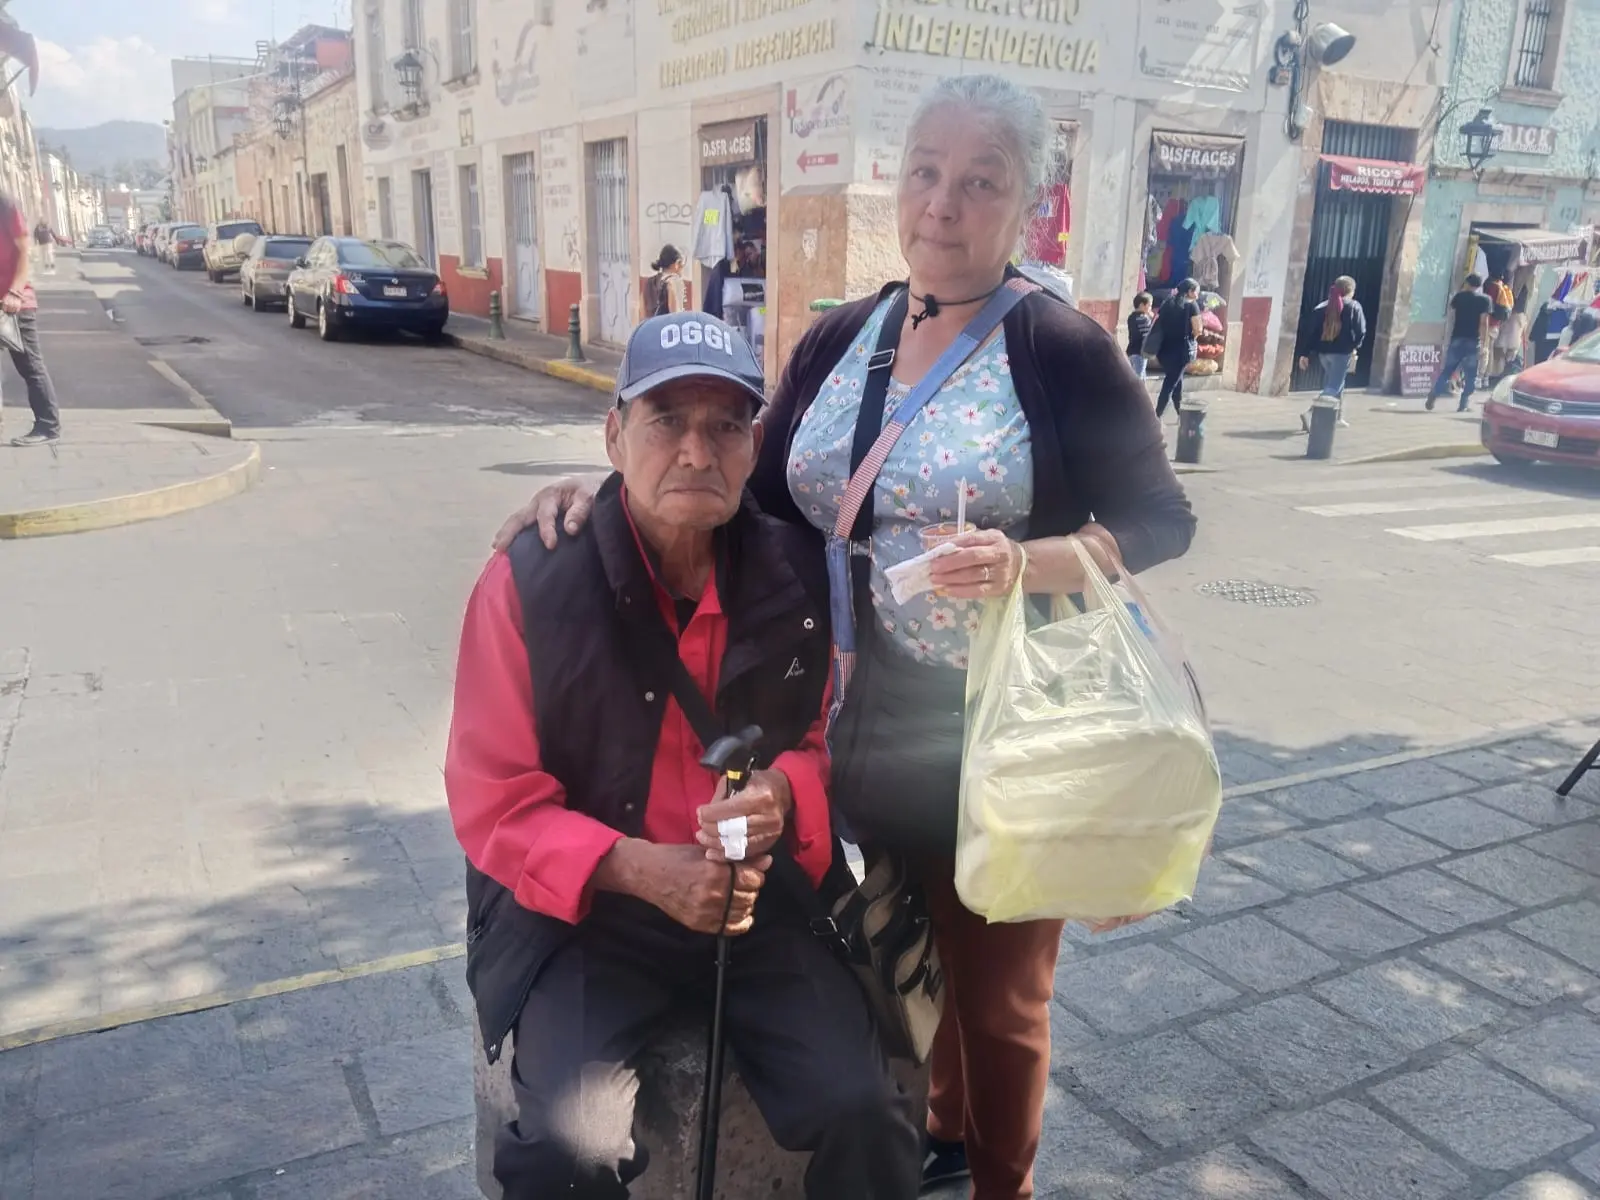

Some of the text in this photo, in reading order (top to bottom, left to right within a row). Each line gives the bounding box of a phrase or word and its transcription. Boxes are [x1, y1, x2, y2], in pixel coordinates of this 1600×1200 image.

[733, 17, 837, 71] INDEPENDENCIA
[875, 11, 1099, 74] INDEPENDENCIA
[1160, 144, 1236, 167] DISFRACES
[1357, 166, 1403, 179] RICO'S
[660, 321, 733, 356] OGGI
[1400, 351, 1440, 364] ERICK
